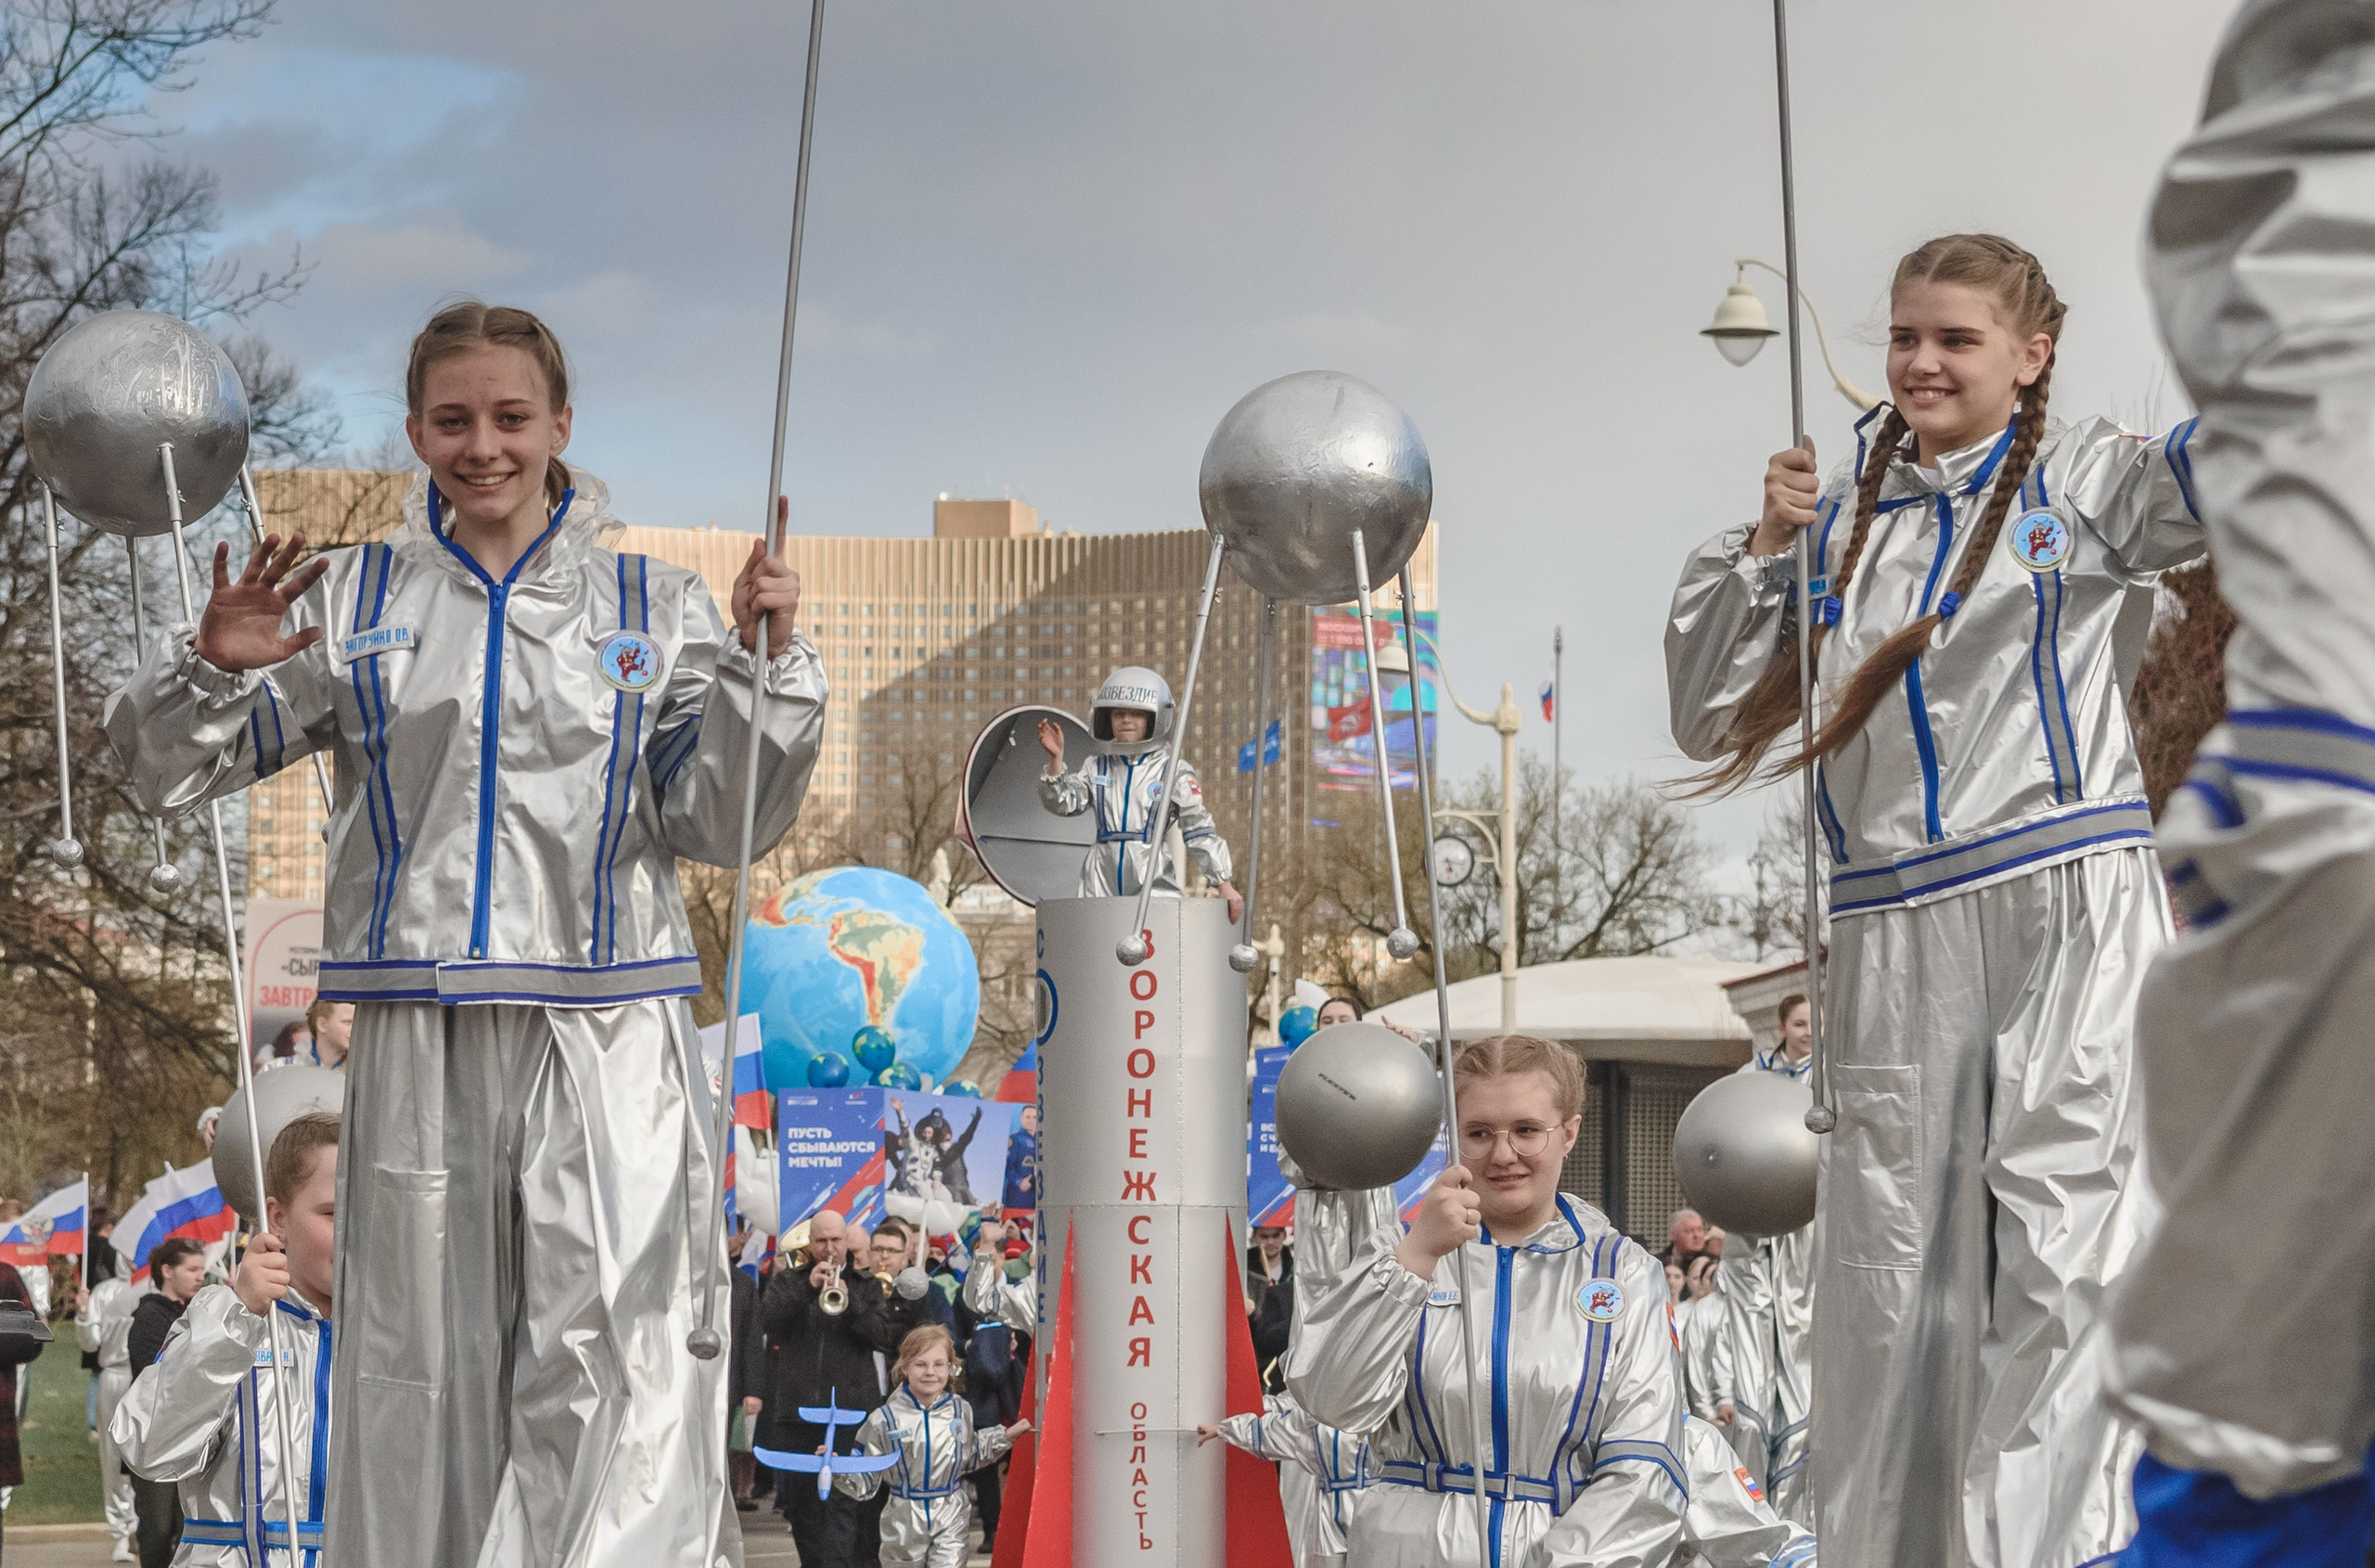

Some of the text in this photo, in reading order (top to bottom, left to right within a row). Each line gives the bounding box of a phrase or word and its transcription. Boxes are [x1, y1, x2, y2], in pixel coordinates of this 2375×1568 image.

[345, 629, 391, 656] ЗАГОРУЙКО
[1097, 686, 1158, 705] ОЗВЕЗДИЕ
[788, 1127, 832, 1138] ПУСТЬ
[788, 1141, 876, 1153] СБЫВАЮТСЯ
[789, 1156, 842, 1168] МЕЧТЫ!
[1129, 1402, 1153, 1550] ОБЛАСТЬ
